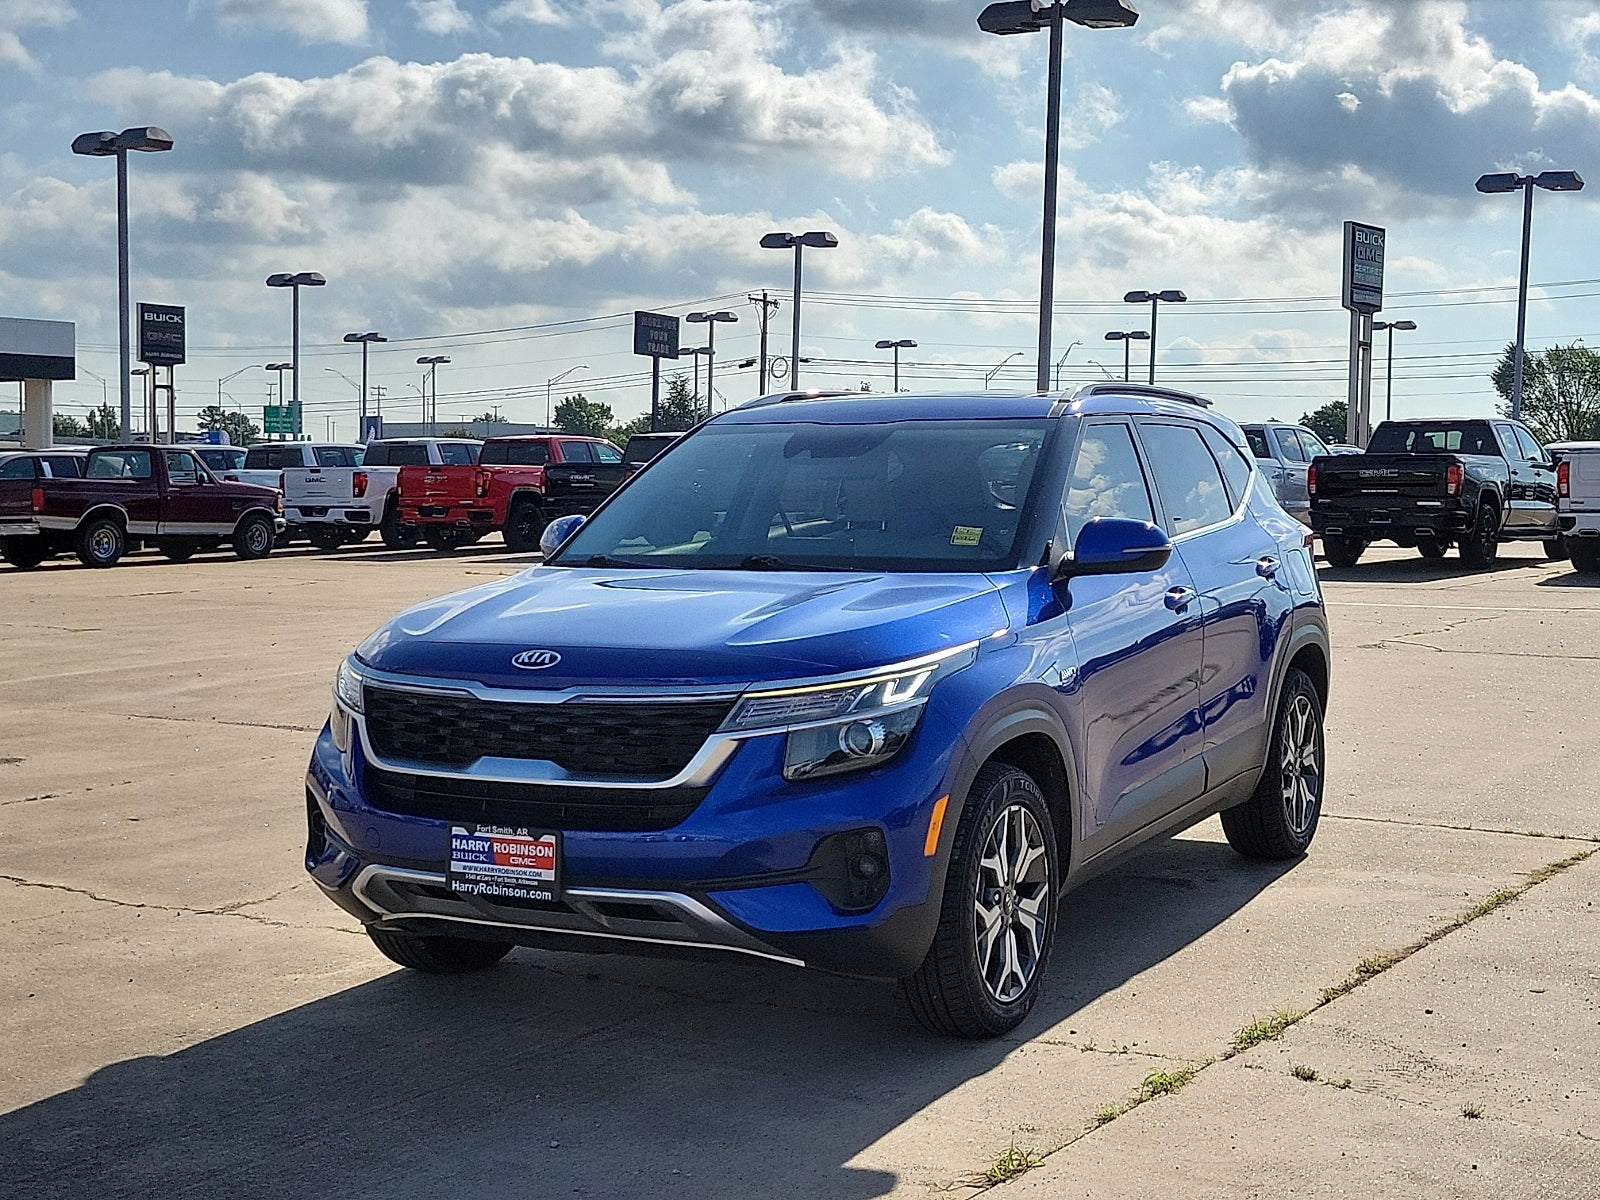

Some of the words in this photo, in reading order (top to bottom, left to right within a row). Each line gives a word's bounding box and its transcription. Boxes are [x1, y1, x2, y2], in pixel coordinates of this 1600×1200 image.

[1355, 231, 1384, 246] BUICK
[1357, 246, 1383, 263] GMC
[144, 312, 183, 323] BUICK
[147, 331, 182, 342] GMC
[1359, 469, 1399, 478] GMC
[476, 824, 491, 833] Fort
[492, 826, 515, 836] Smith,
[516, 828, 529, 836] AR
[451, 838, 491, 852] HARRY
[493, 842, 554, 858] ROBINSON
[451, 851, 489, 862] BUICK
[509, 856, 538, 866] GMC
[462, 864, 544, 878] WWW.HARRYROBINSON.COM
[451, 880, 552, 901] HarryRobinson.com
